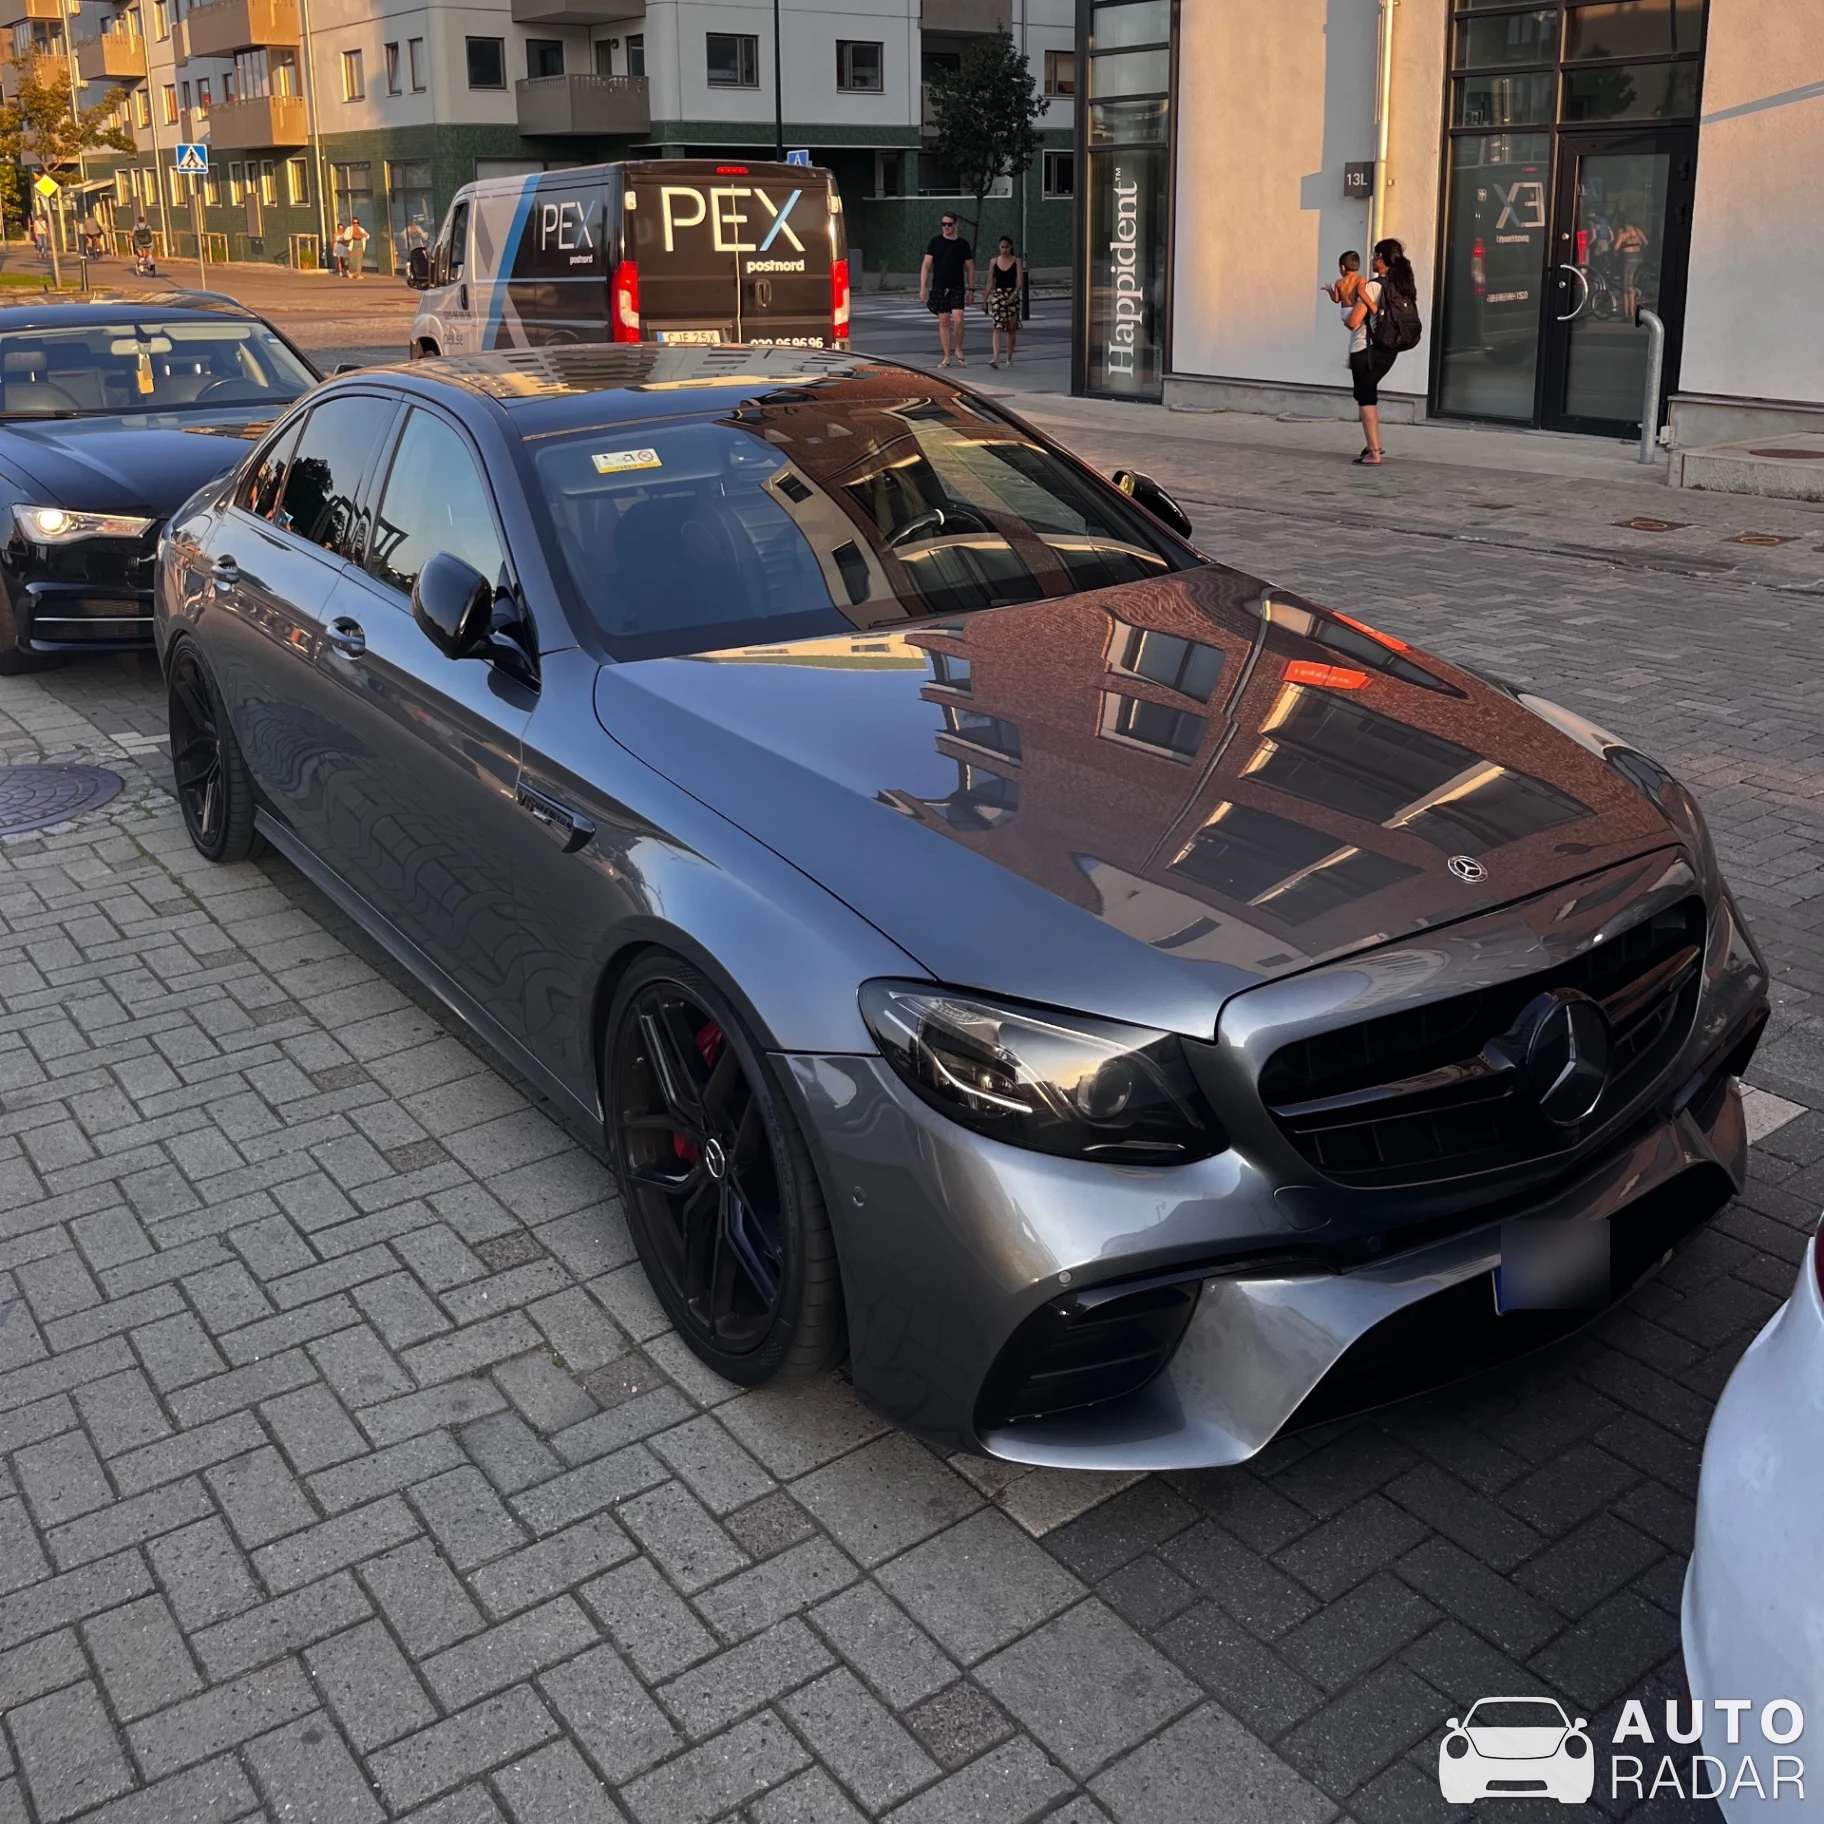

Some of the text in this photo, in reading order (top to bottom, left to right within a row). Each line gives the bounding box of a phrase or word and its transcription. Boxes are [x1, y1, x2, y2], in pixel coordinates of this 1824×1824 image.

[1346, 172, 1368, 186] 13L
[542, 200, 595, 251] PEX
[661, 186, 806, 252] PEX
[746, 259, 805, 274] postnord
[792, 336, 808, 347] 96
[808, 336, 824, 349] 96
